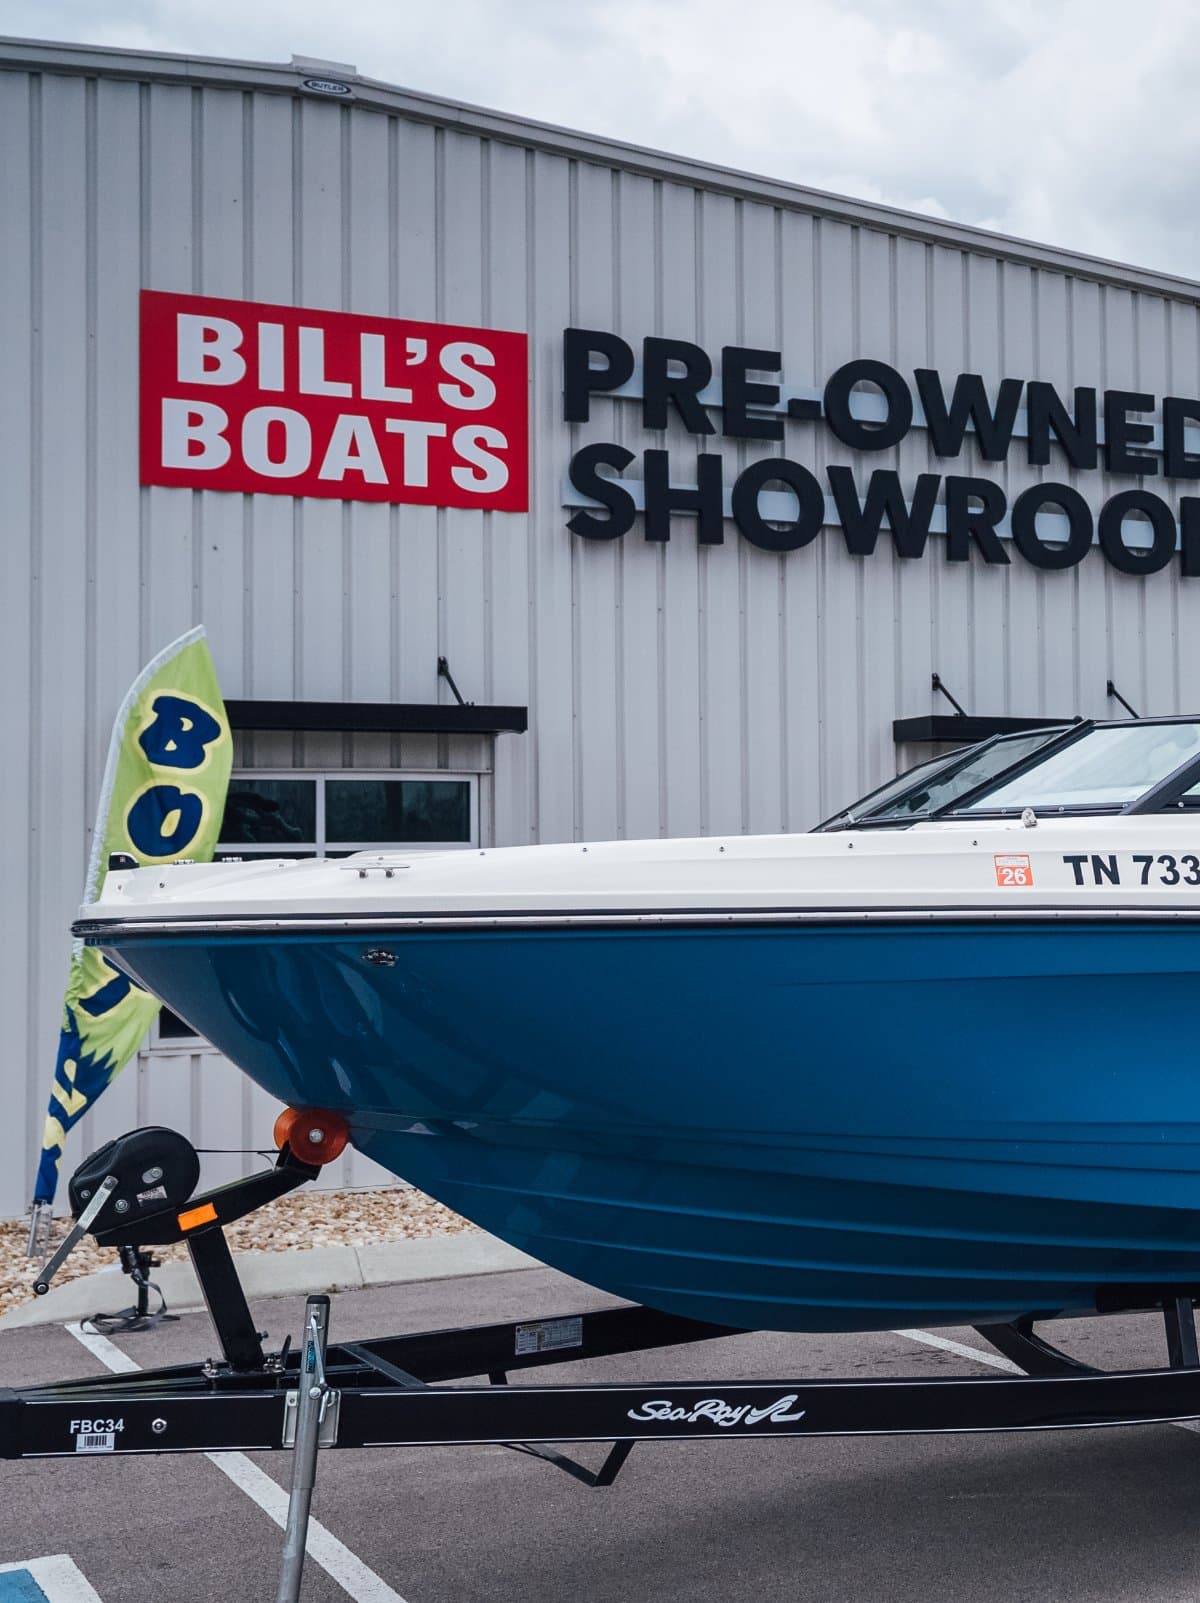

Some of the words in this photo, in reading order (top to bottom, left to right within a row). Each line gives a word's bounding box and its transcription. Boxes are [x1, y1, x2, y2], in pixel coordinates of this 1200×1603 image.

[176, 312, 497, 411] BILL'S
[160, 397, 510, 494] BOATS
[1001, 867, 1027, 886] 26
[1062, 854, 1121, 886] TN
[69, 1418, 125, 1434] FBC34
[627, 1400, 693, 1421] Sea
[687, 1399, 751, 1427] Ray
